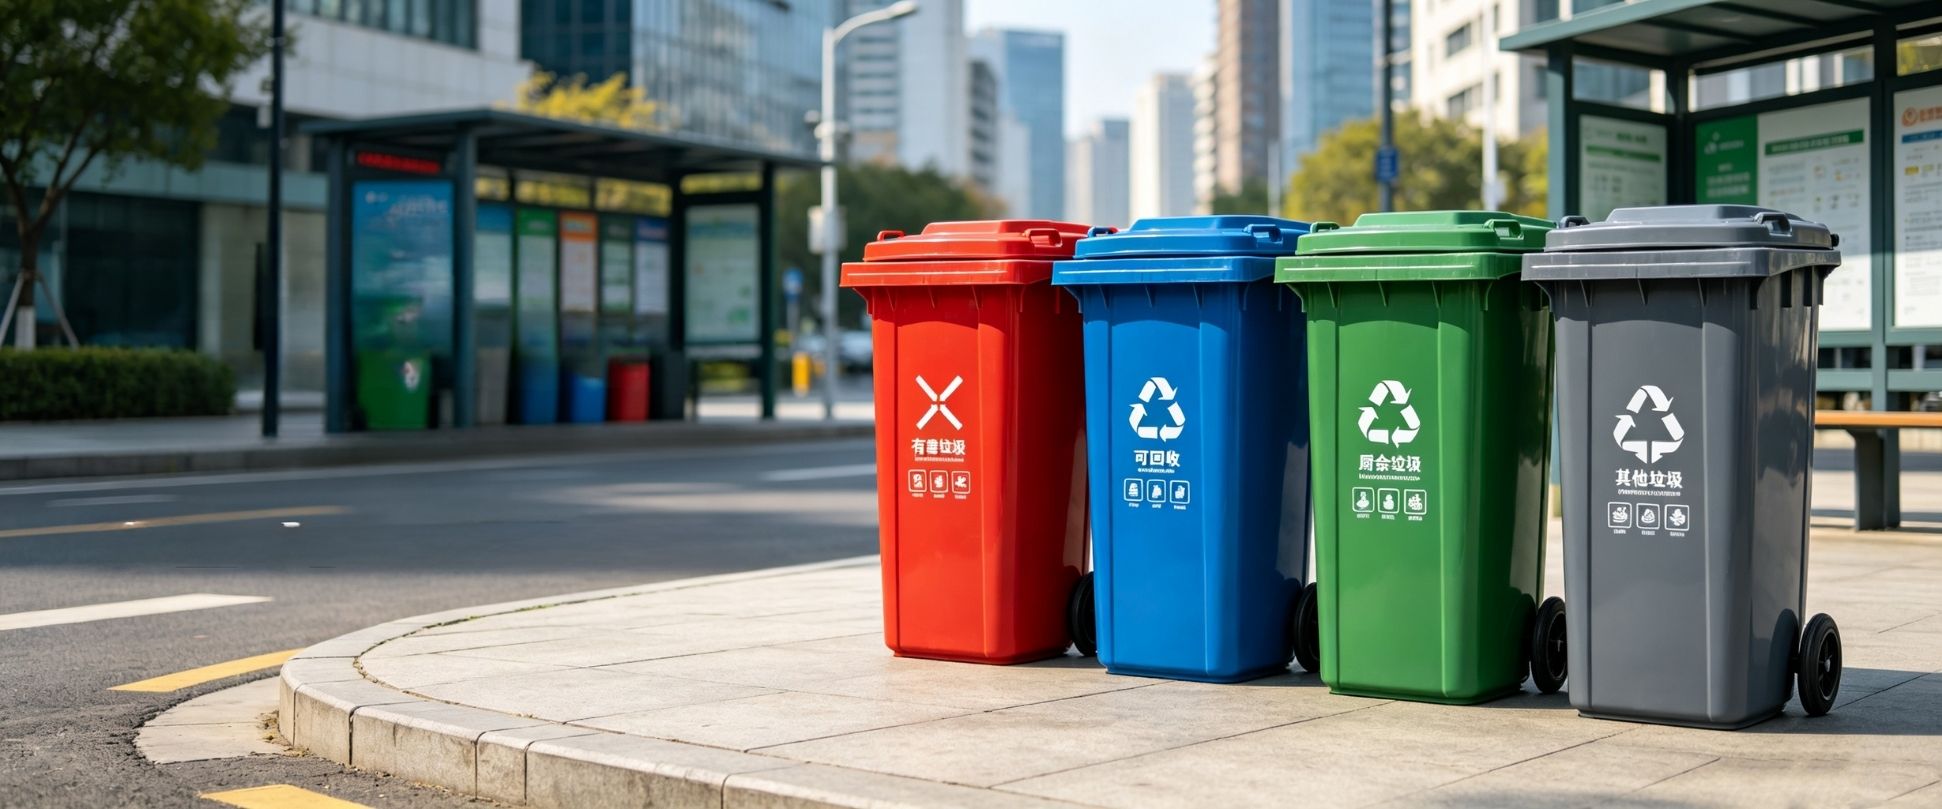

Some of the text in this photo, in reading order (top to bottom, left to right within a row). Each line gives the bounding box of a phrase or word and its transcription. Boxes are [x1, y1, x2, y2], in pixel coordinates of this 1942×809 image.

[1133, 450, 1181, 467] 可回收
[1615, 468, 1683, 488] 其他垃圾
